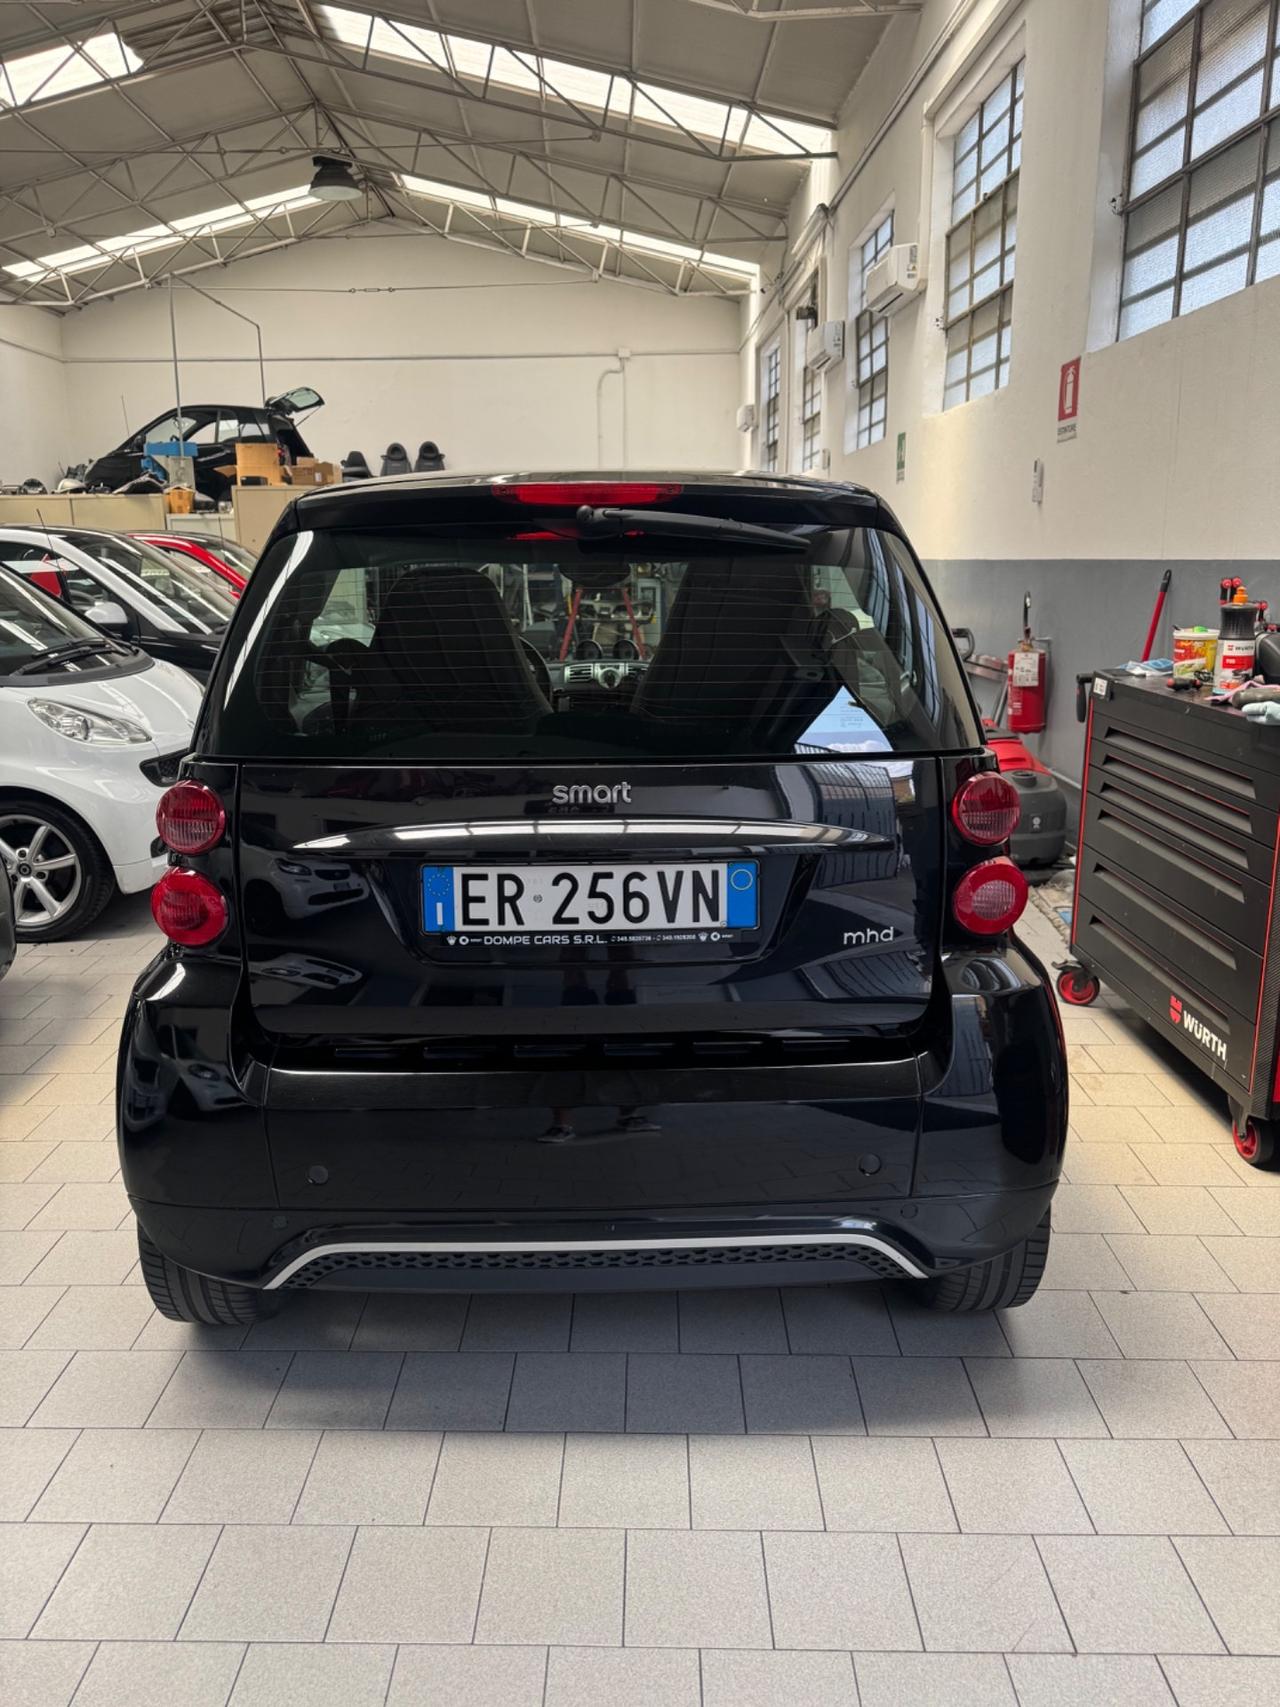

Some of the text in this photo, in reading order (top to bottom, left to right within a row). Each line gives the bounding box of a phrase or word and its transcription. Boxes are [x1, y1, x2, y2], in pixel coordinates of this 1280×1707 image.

[552, 781, 632, 804] smart
[461, 870, 719, 926] ER 256VN
[484, 935, 531, 945] DOMPE
[534, 935, 570, 944] CARS
[573, 934, 608, 944] S.R.L.
[843, 926, 894, 945] mhd
[1183, 1010, 1227, 1061] WÜRTH
